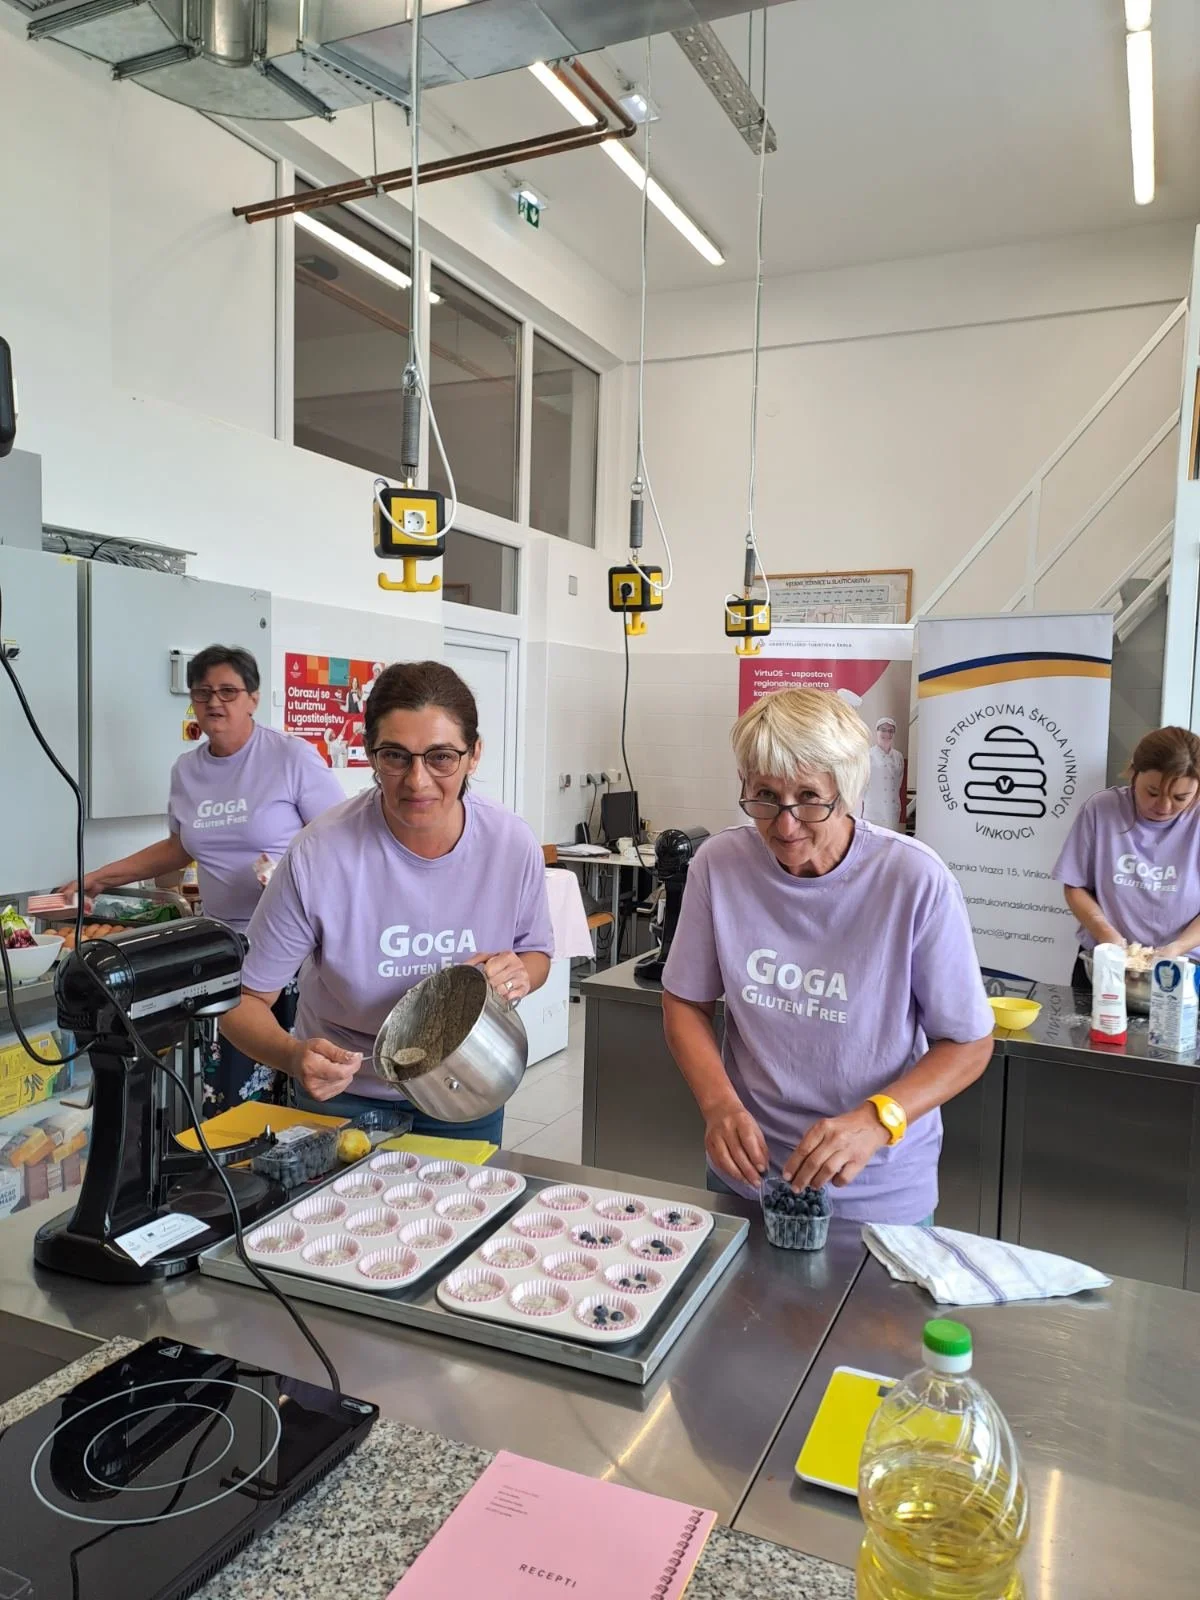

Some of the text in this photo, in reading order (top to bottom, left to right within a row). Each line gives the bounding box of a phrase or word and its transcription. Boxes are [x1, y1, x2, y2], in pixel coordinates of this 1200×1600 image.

[754, 669, 783, 677] VirtuOS
[791, 670, 833, 679] uspostava
[287, 687, 330, 701] Obrazuj se
[294, 700, 326, 711] turizmu
[287, 711, 345, 726] i ugostiteljstvu
[937, 703, 1078, 819] SREDNJA STRUKOVNA ŠKOLA VINKOVCI
[197, 798, 248, 818] GOGA
[192, 818, 226, 829] GLUTEN
[975, 821, 1035, 841] VINKOVCI
[948, 862, 977, 873] Stanka
[979, 864, 1004, 876] Vraza
[1007, 867, 1020, 878] 15,
[1116, 853, 1177, 881] GOGA
[1112, 873, 1152, 891] GLUTEN
[379, 924, 477, 958] GOGA
[377, 960, 437, 978] GLUTEN
[746, 948, 848, 1001] GOGA
[741, 984, 848, 1024] GLUTEN FREE
[519, 1563, 577, 1589] RECEPTI
